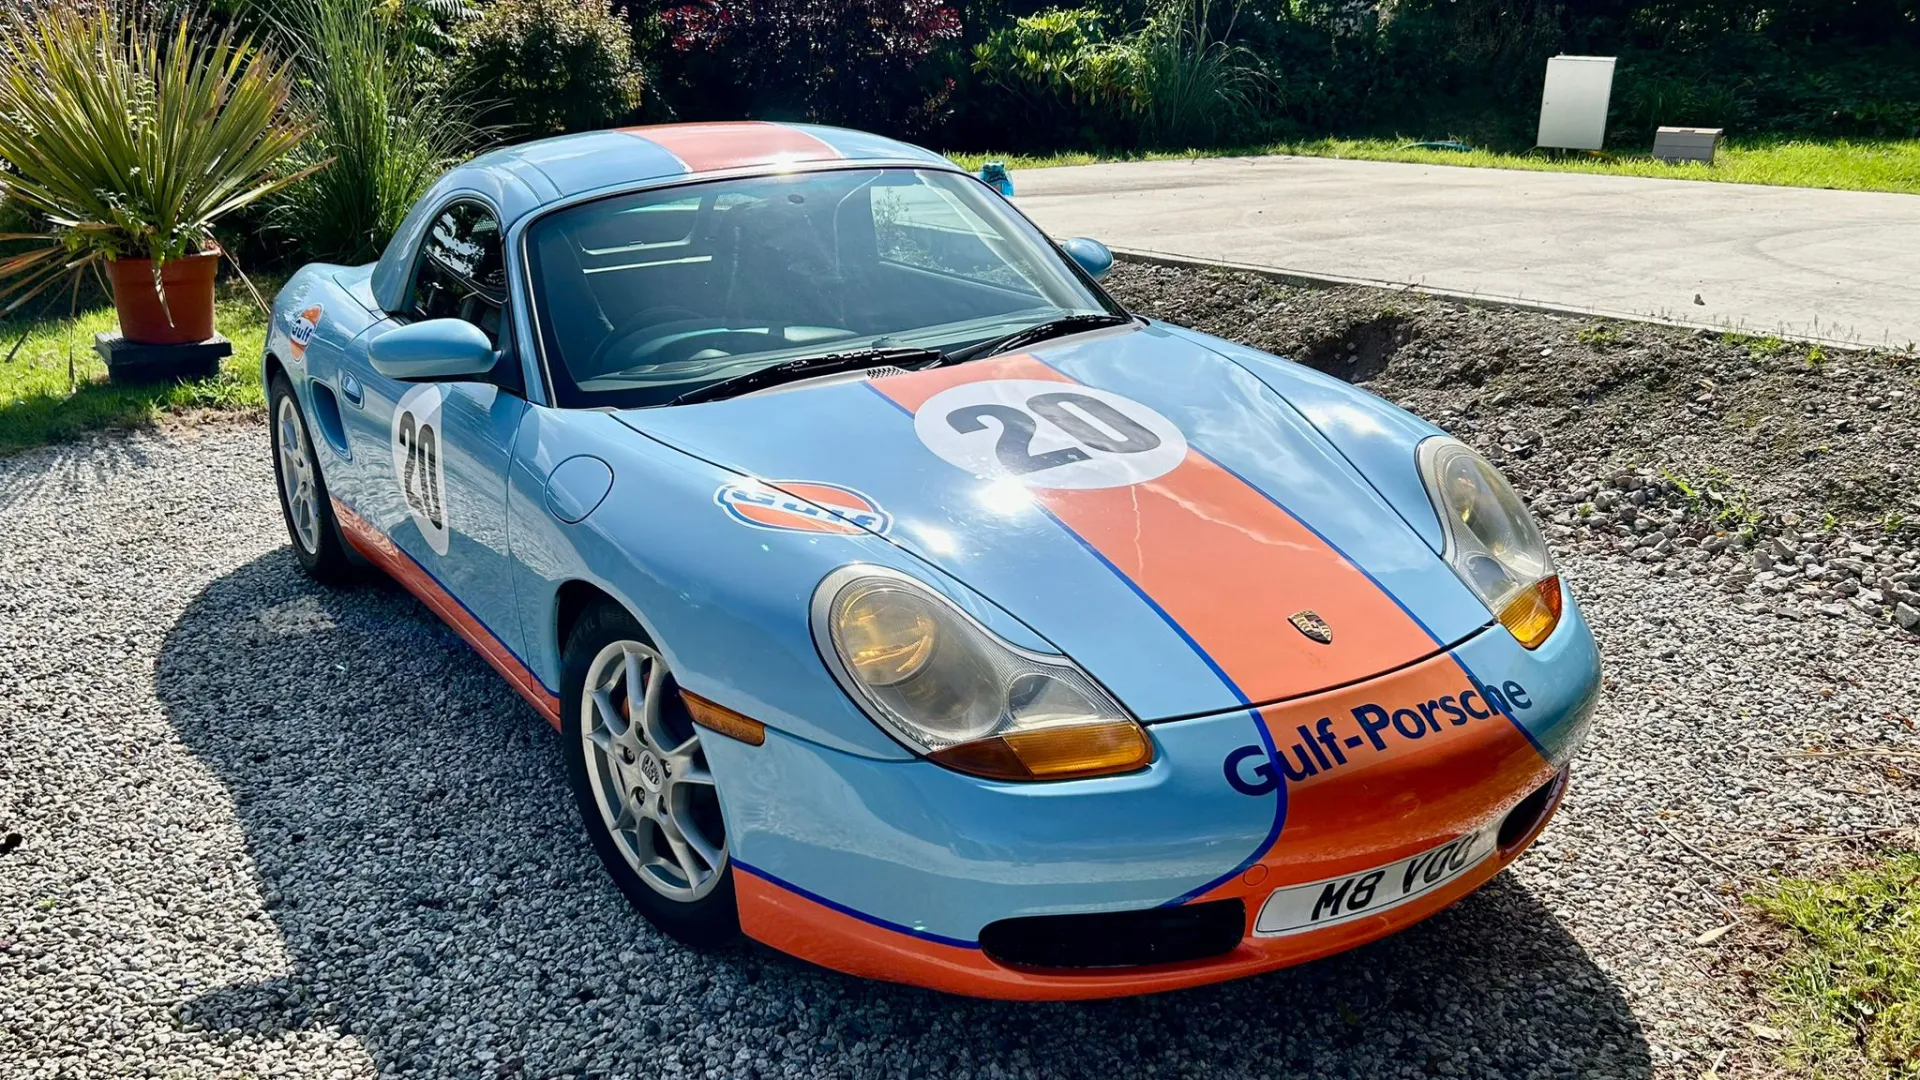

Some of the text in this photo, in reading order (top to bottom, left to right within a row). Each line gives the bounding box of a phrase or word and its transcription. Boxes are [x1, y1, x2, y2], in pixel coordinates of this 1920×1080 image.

[291, 318, 313, 342] Gulf
[946, 392, 1162, 477] 20
[399, 410, 443, 531] 20
[731, 487, 877, 528] Gulf
[1223, 675, 1533, 797] Gulf-Porsche
[1310, 869, 1386, 922] M8
